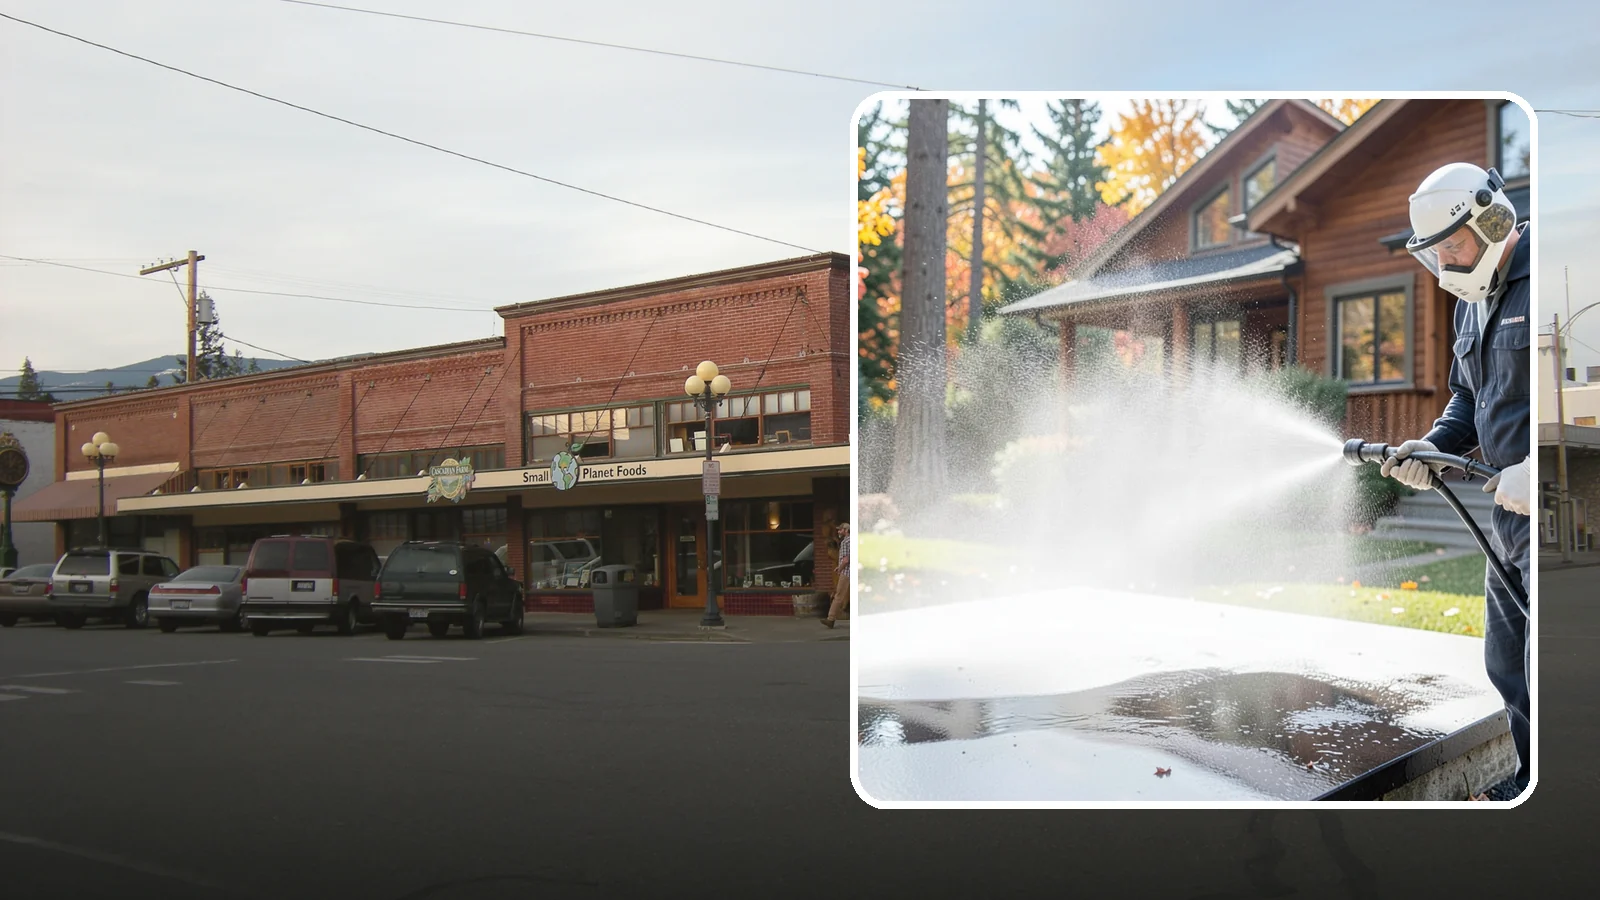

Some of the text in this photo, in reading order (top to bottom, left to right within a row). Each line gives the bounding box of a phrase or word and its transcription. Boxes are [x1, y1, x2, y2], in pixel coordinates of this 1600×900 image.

[523, 464, 647, 483] Small Planet Foods
